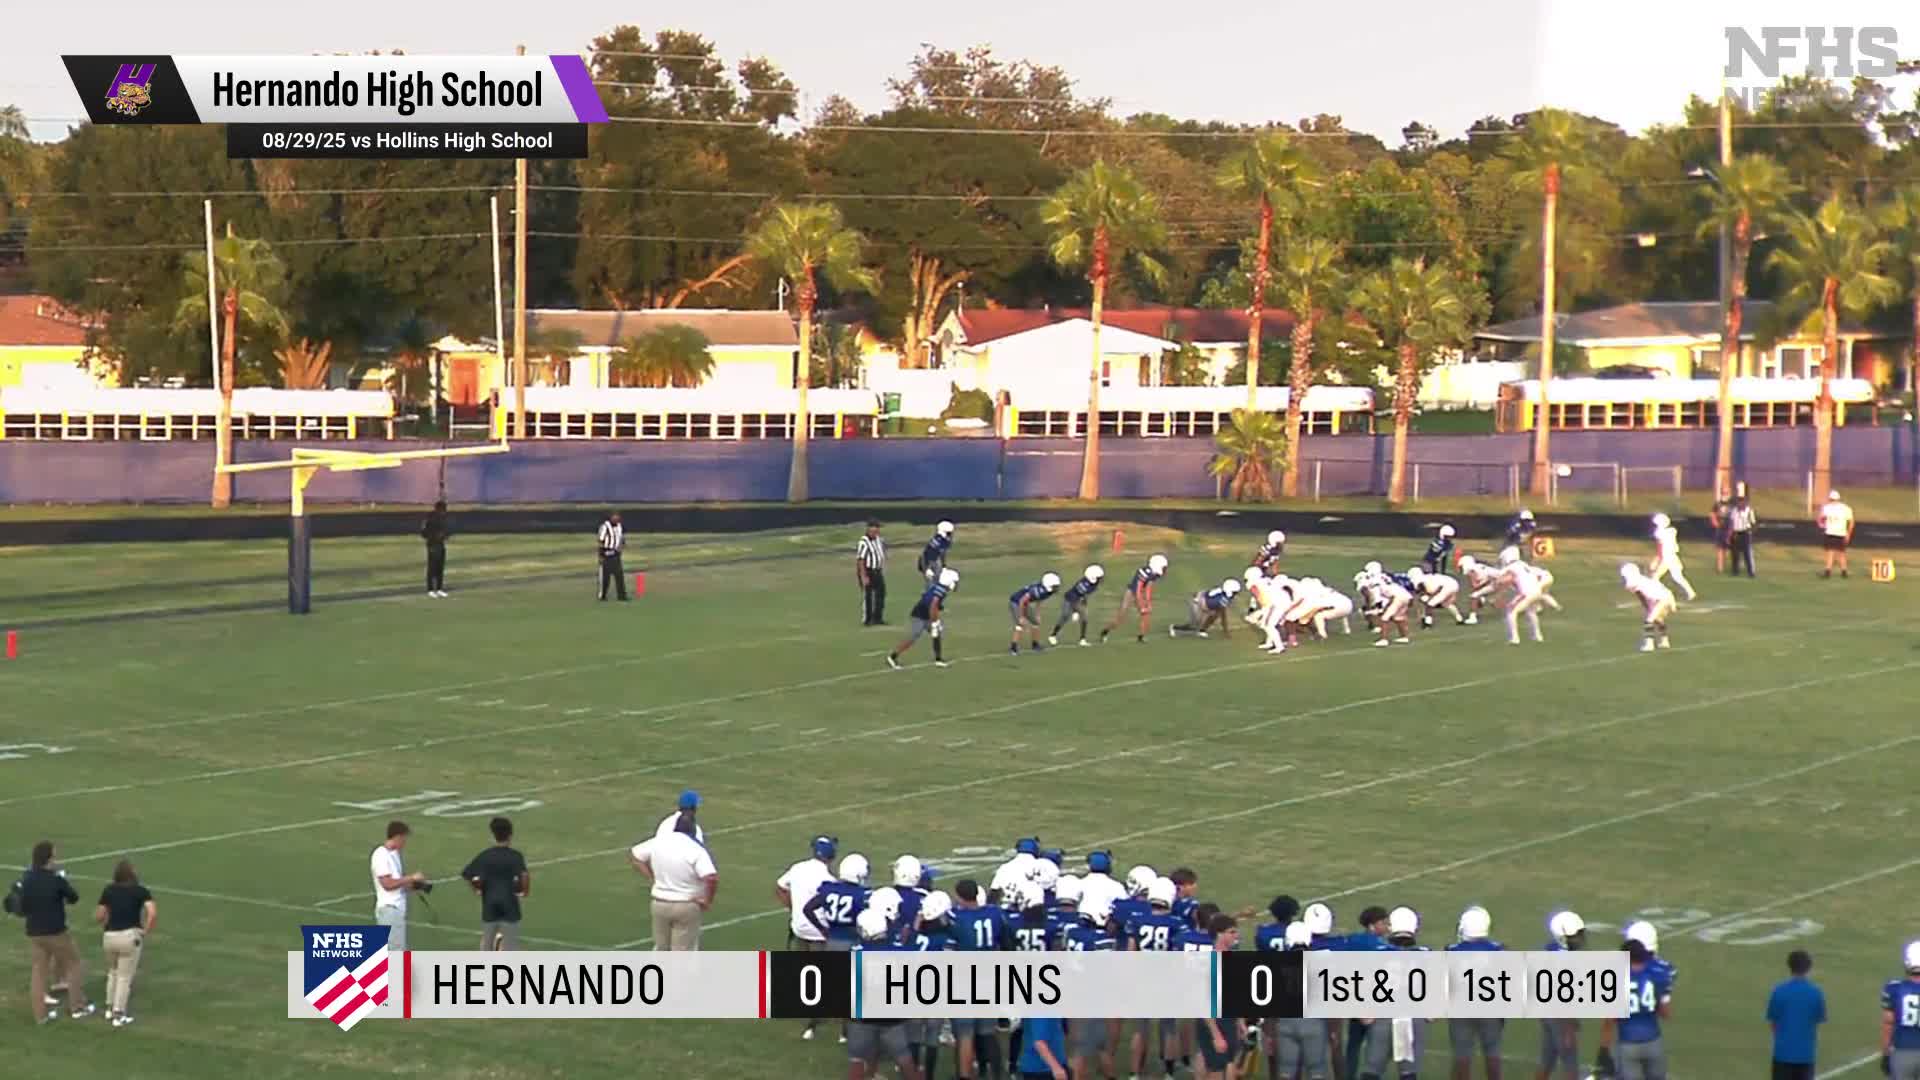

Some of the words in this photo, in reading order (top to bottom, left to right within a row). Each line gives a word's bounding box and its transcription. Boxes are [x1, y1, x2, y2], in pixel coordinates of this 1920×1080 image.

[1874, 561, 1889, 578] 10
[332, 790, 543, 816] 10
[825, 893, 853, 923] 32
[973, 918, 993, 948] 11
[1016, 929, 1046, 951] 35
[1139, 924, 1169, 951] 28
[1902, 994, 1920, 1026] 6
